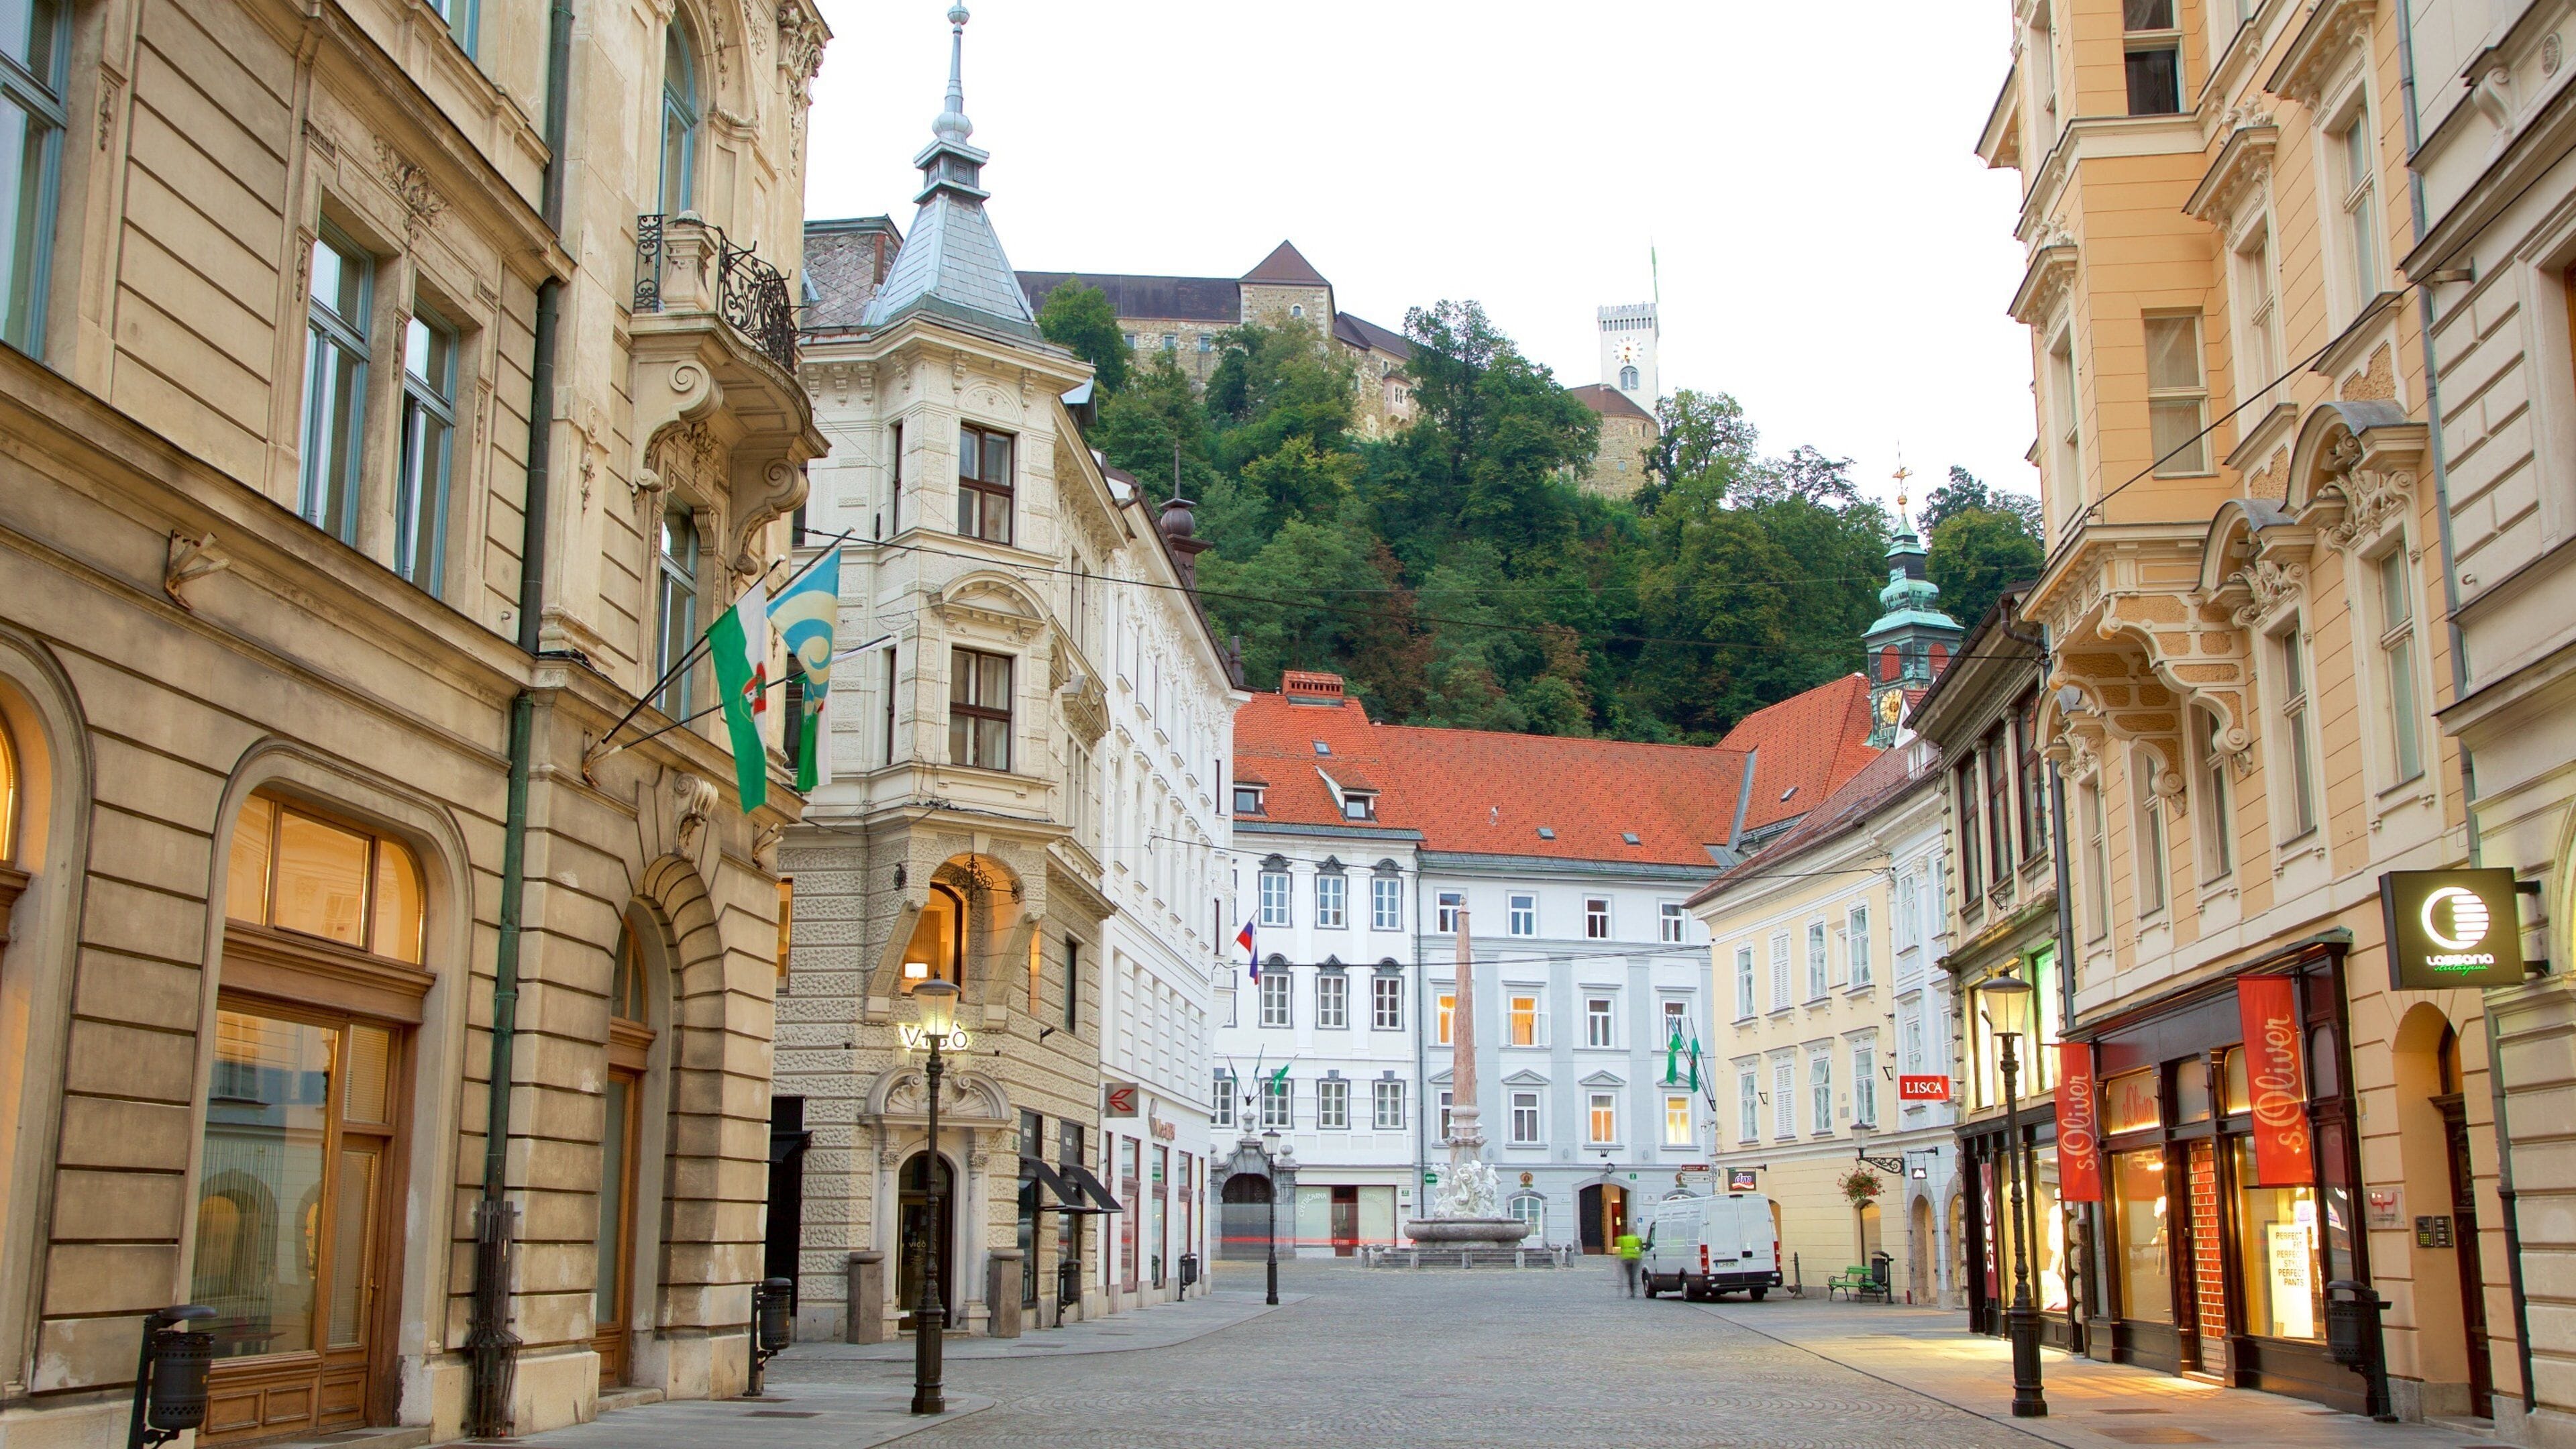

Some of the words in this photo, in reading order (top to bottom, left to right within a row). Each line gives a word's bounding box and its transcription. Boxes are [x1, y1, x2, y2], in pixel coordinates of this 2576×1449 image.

[1905, 1081, 1943, 1093] LISCA
[2253, 1014, 2304, 1152] s.Oliver
[2061, 1072, 2095, 1171] s.Oliver
[1734, 1173, 1752, 1183] dm
[1983, 1186, 1995, 1273] LISCA
[2275, 1232, 2302, 1240] PERFECT
[2276, 1250, 2303, 1258] PERFECT
[2277, 1269, 2304, 1277] PERFECT
[2284, 1278, 2304, 1286] PANTS
